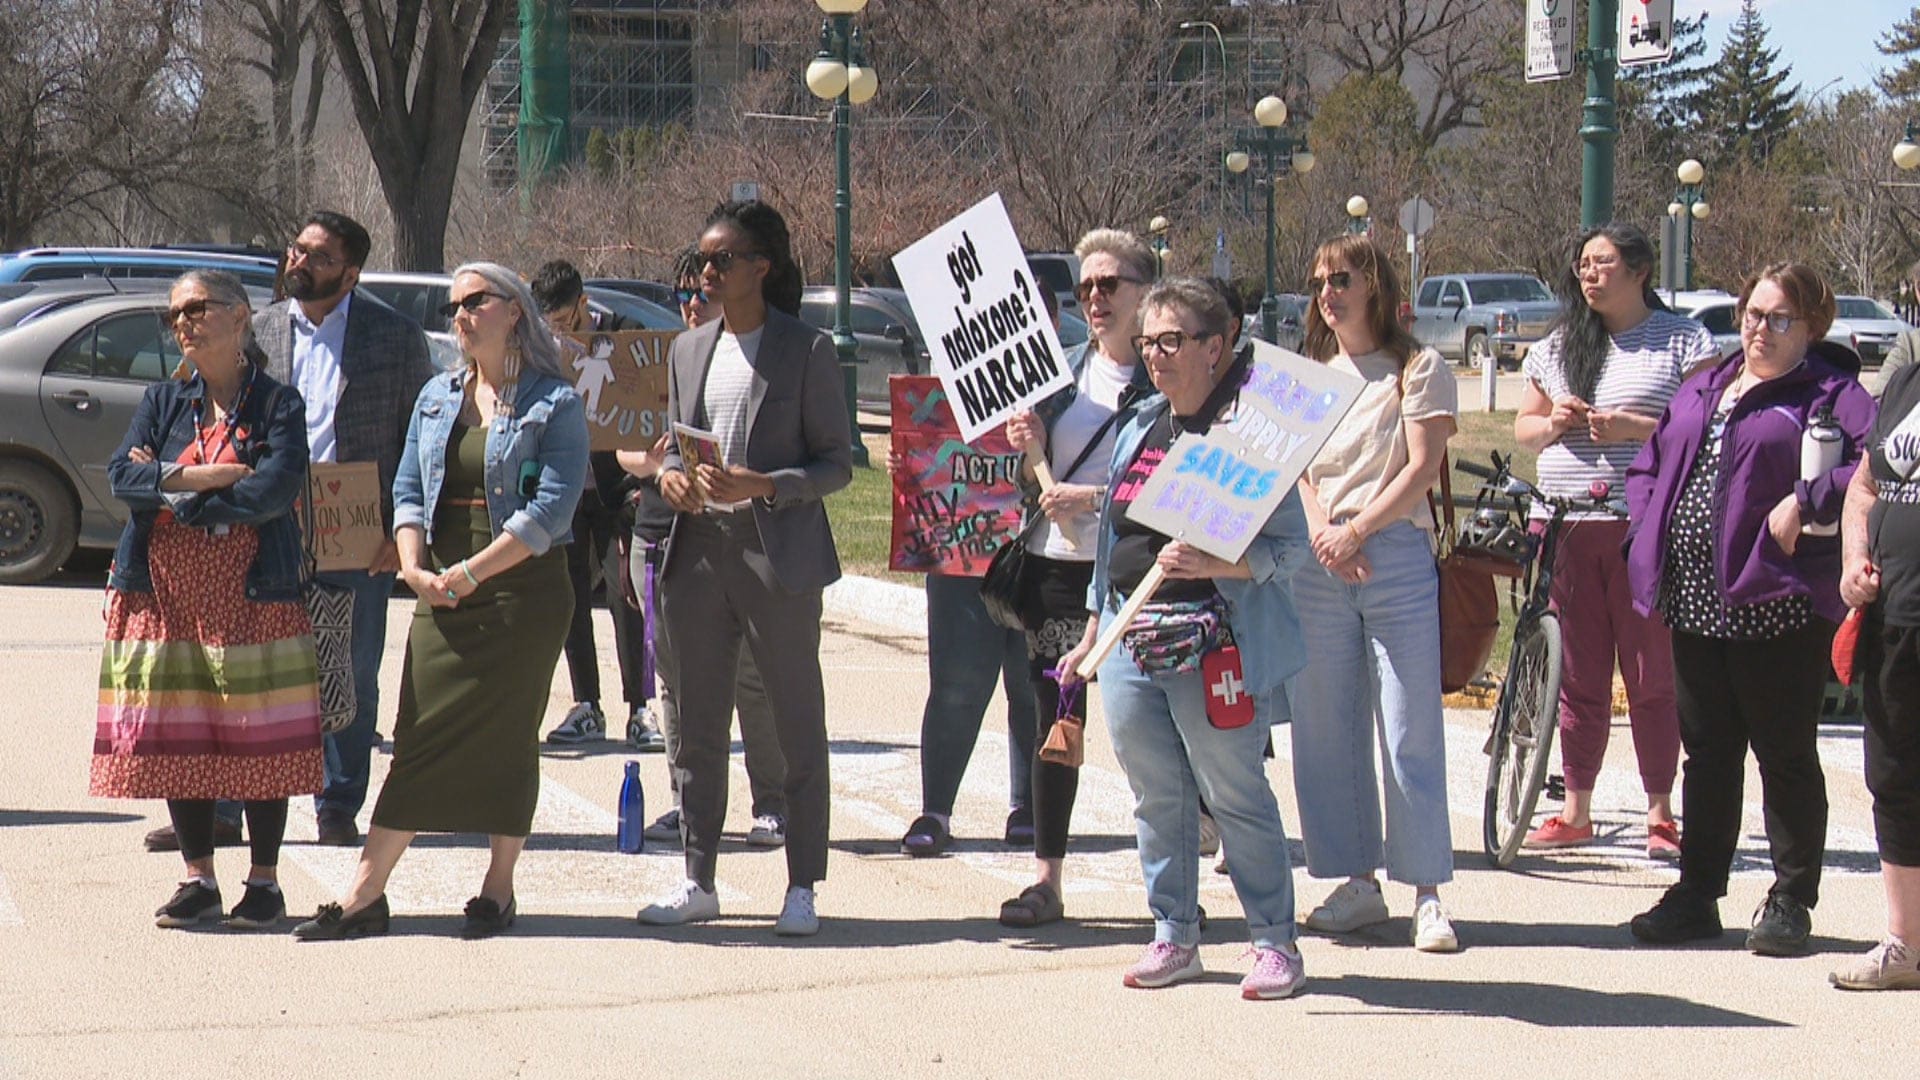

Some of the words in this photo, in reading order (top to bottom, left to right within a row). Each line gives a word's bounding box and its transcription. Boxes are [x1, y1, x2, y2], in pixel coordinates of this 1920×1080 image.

[946, 230, 983, 304] got
[941, 269, 1038, 370] naloxone?
[629, 337, 672, 368] HI
[955, 329, 1059, 427] NARCAN
[1227, 402, 1312, 463] UPPLY
[952, 454, 997, 486] ACT
[1175, 443, 1280, 500] SAVES
[907, 488, 958, 527] HIV
[1152, 479, 1256, 544] LIVES
